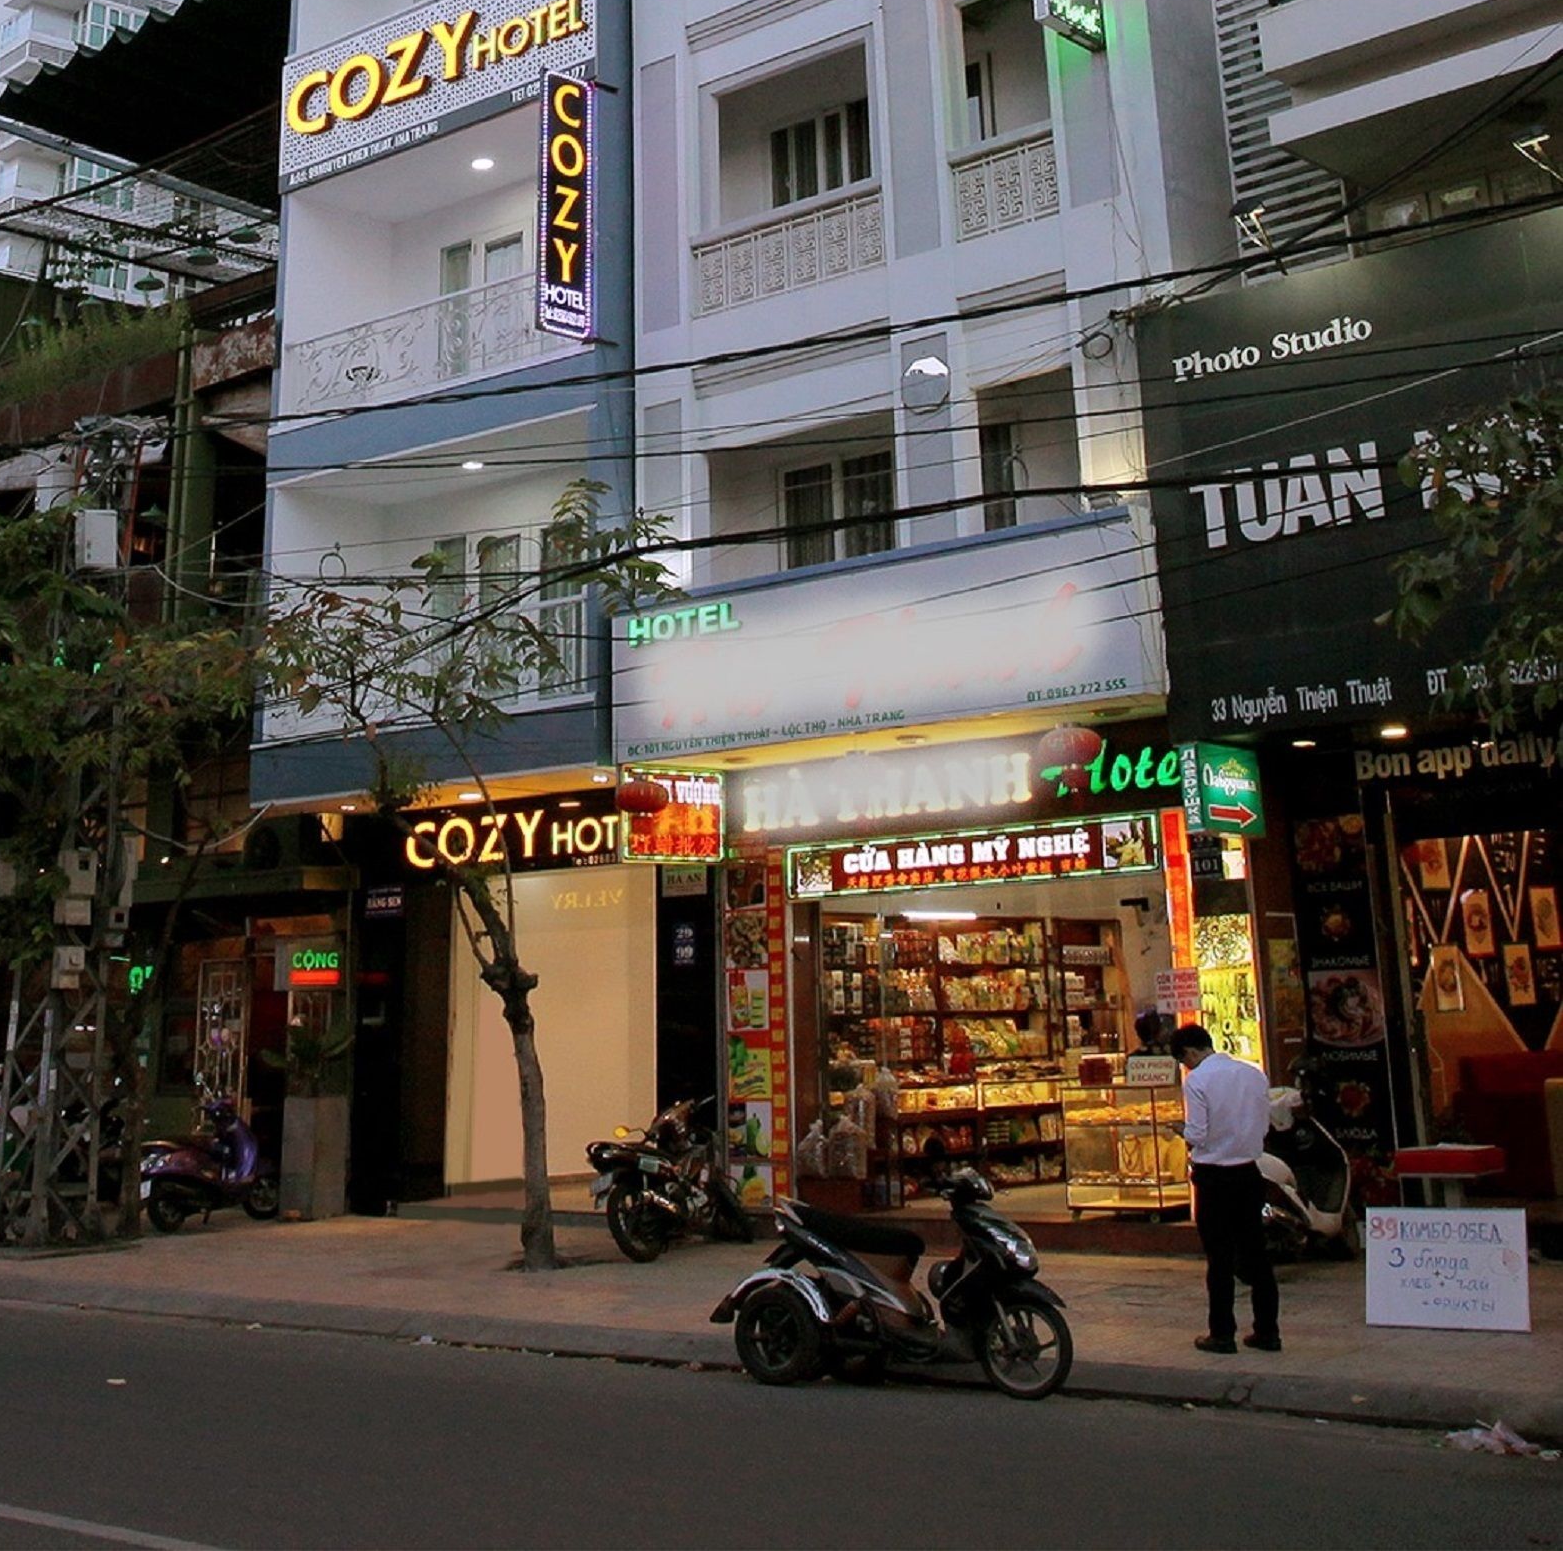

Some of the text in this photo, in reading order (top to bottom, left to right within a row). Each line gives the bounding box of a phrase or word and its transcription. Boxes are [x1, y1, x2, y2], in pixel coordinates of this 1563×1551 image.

[286, 11, 477, 135] COZY
[550, 84, 585, 284] COZY
[544, 283, 586, 311] HOTEL
[1172, 316, 1373, 384] Photo Studio
[1189, 440, 1386, 550] TUAN
[627, 602, 741, 648] HOTEL
[1105, 677, 1127, 692] 555
[1211, 698, 1227, 723] 33
[1230, 685, 1287, 725] Nguyễn
[1296, 684, 1338, 713] Thiện
[1345, 677, 1393, 706] Thuật
[837, 715, 862, 729] NHA
[865, 709, 906, 724] TRANG
[1354, 749, 1412, 781] Bon
[405, 809, 544, 869] COZY
[550, 815, 619, 855] HOT
[842, 826, 1092, 874] CỬA HÀNG MỸ NGHỆ
[1194, 858, 1219, 873] 101
[292, 949, 339, 970] CỘNG
[1369, 1215, 1398, 1241] 89
